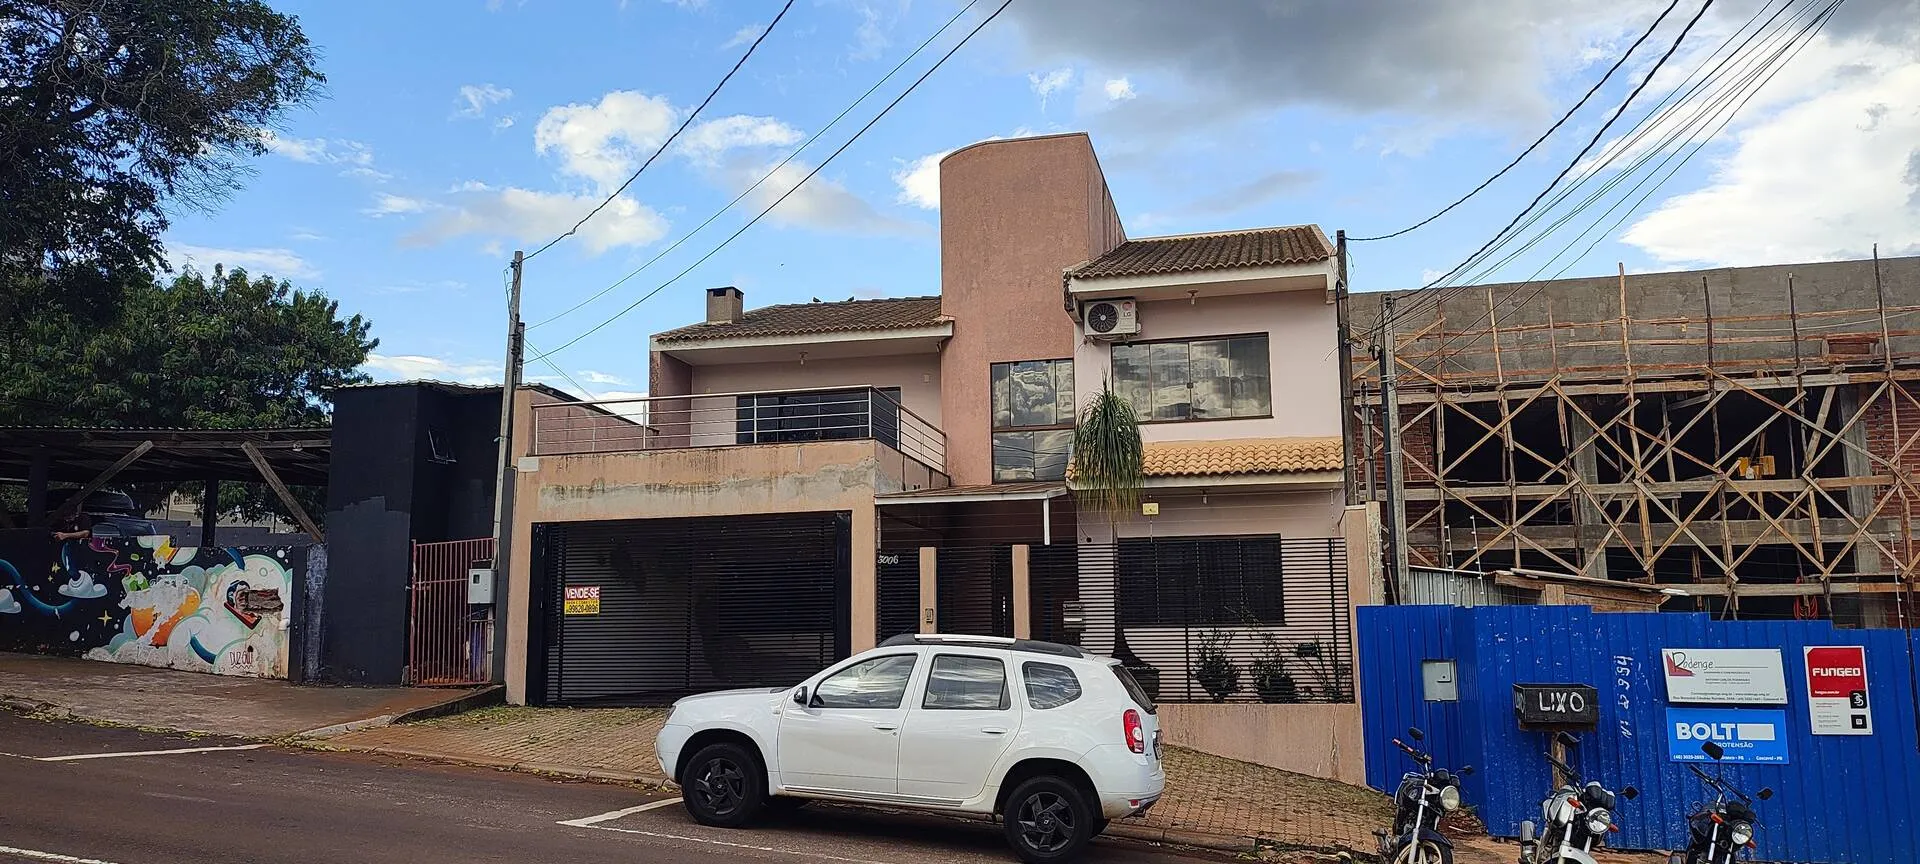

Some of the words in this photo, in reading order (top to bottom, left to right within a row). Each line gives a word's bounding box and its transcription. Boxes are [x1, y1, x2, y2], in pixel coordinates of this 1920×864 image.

[565, 587, 600, 600] VENDE-SE
[1539, 691, 1585, 713] LIXO
[1675, 722, 1736, 741] BOLT
